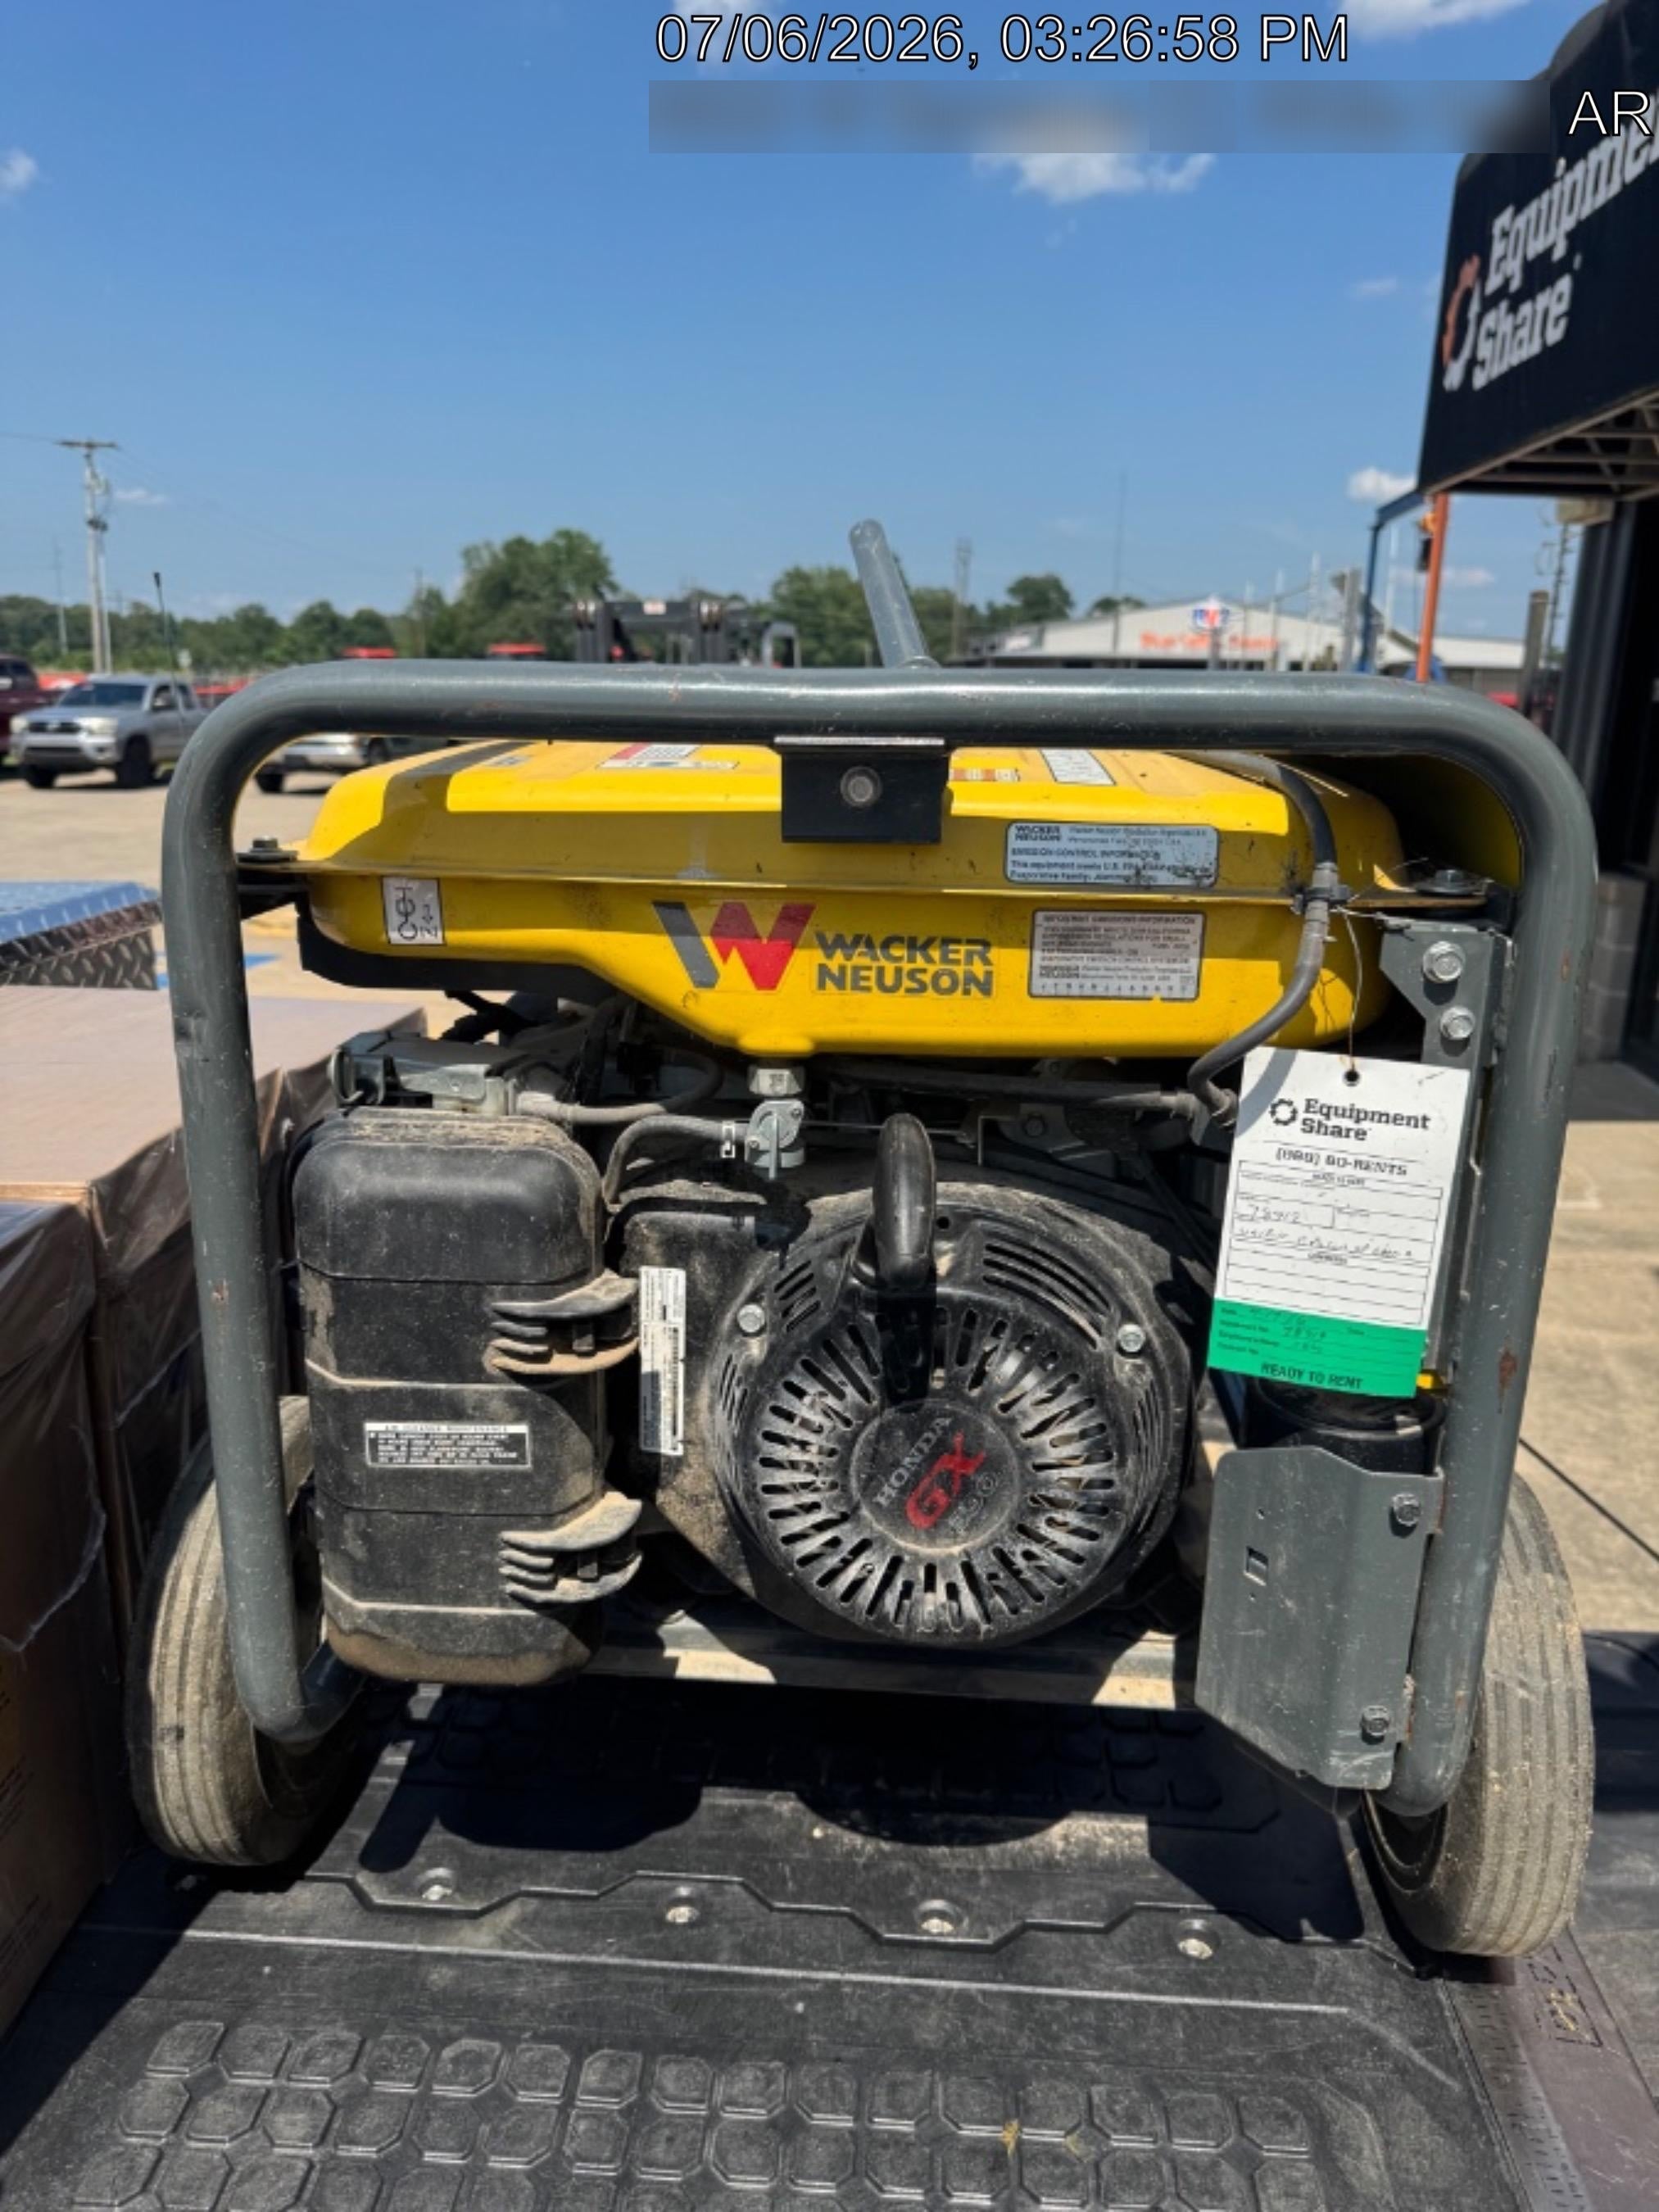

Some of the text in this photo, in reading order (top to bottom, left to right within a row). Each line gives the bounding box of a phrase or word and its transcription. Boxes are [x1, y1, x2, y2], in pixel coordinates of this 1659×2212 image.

[1472, 273, 1573, 391] Share
[815, 932, 994, 966] WACKER
[817, 963, 993, 997] NEUSON
[1300, 1117, 1367, 1141] Share
[1303, 1098, 1432, 1131] Equipment
[1261, 1362, 1363, 1389] READY TO RENT
[872, 1417, 953, 1507] HONDA
